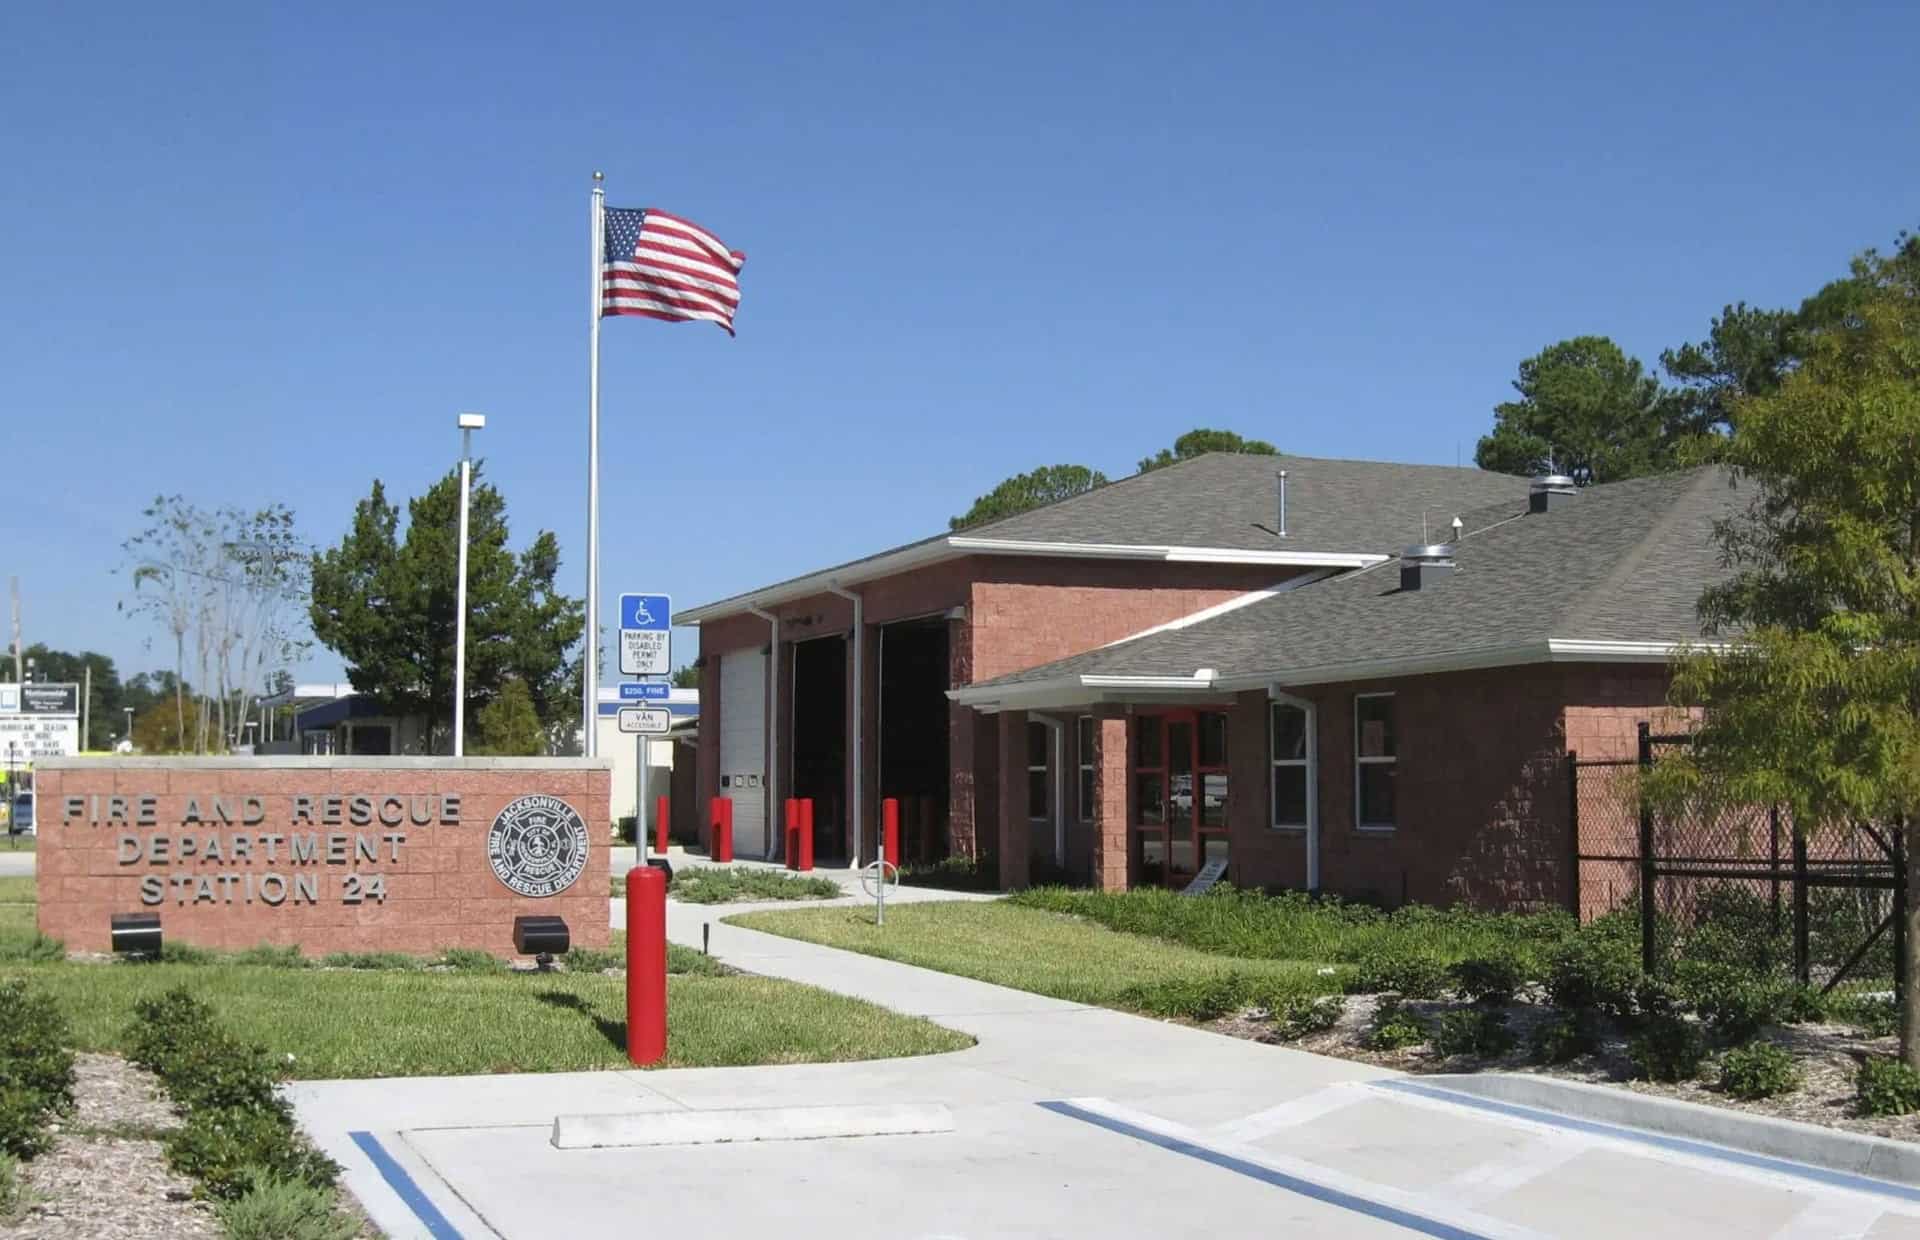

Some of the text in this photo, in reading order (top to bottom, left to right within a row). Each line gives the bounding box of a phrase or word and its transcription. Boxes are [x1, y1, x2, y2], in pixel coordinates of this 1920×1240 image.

[625, 631, 666, 641] PARKING BY
[628, 641, 662, 650] DISABLED
[632, 651, 657, 660] PERMIT
[636, 660, 654, 669] ONLY
[646, 686, 665, 695] FINE
[636, 712, 654, 721] VAN
[62, 792, 462, 827] FIRE AND RESCUE
[500, 797, 576, 826] JACKSONVILLE
[116, 832, 407, 867] DEPARTMENT
[489, 830, 502, 856] FIRE
[553, 826, 587, 889] DEPARTMENT
[494, 858, 511, 879] AND
[140, 872, 389, 906] STATION 24
[508, 877, 553, 895] RESCUE
